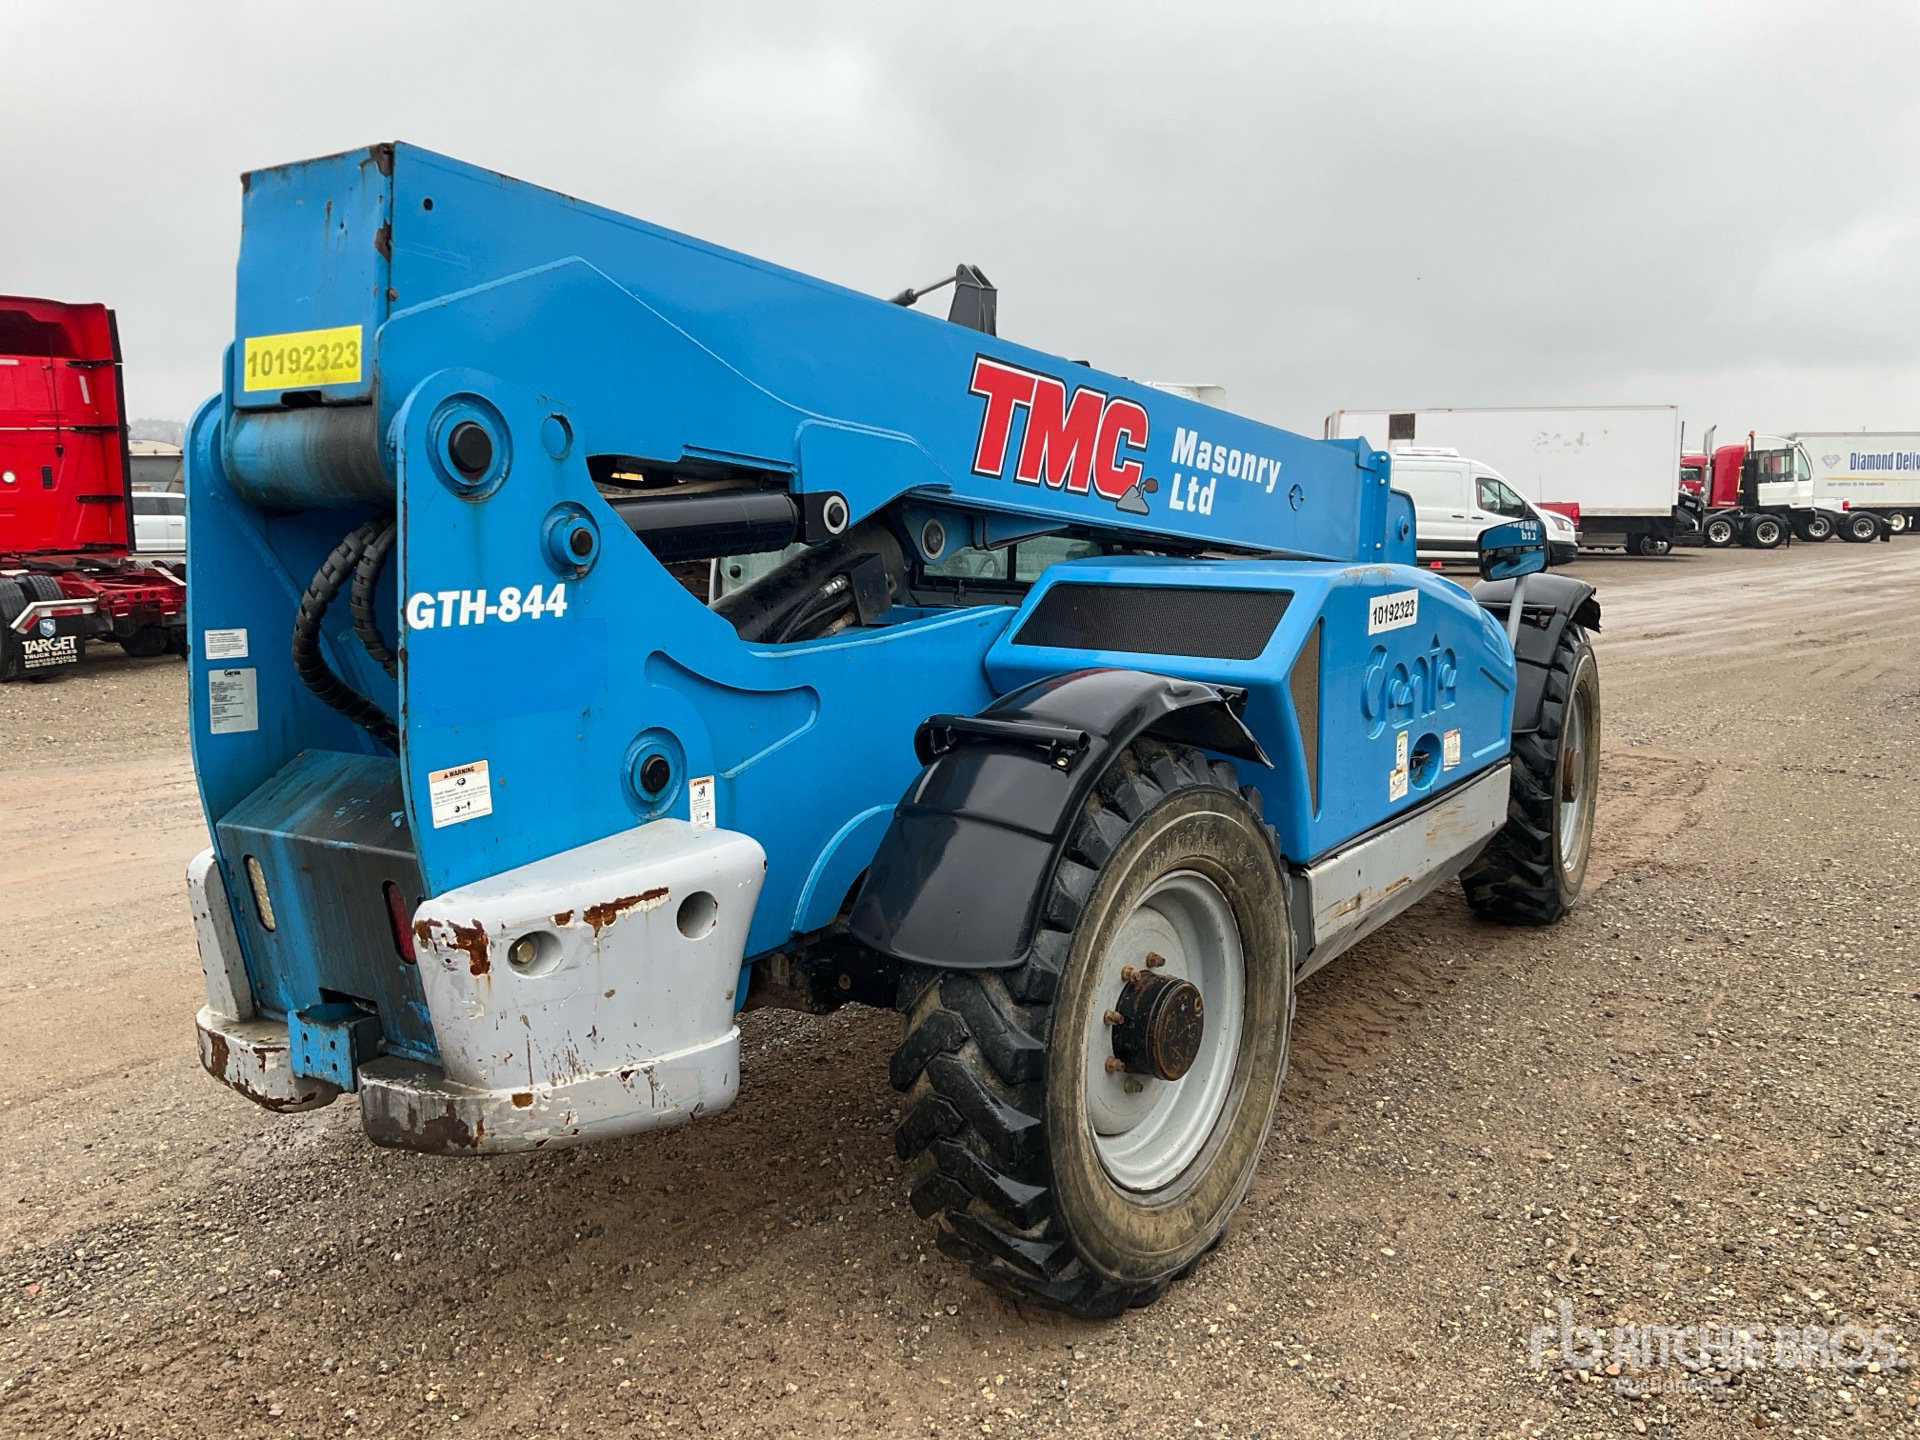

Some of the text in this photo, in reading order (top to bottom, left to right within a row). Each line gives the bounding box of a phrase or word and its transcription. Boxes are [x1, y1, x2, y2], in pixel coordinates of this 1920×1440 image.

[247, 341, 359, 377] 10192323
[968, 352, 1150, 502] TMC
[1171, 427, 1282, 494] Masonry
[1849, 452, 1894, 471] Diamond
[1169, 473, 1217, 516] Ltd
[407, 583, 567, 630] GTH-844
[1373, 599, 1415, 625] 10192323
[22, 635, 77, 654] TARGET
[24, 649, 77, 660] TRUCK SALES
[449, 765, 475, 778] WARNING
